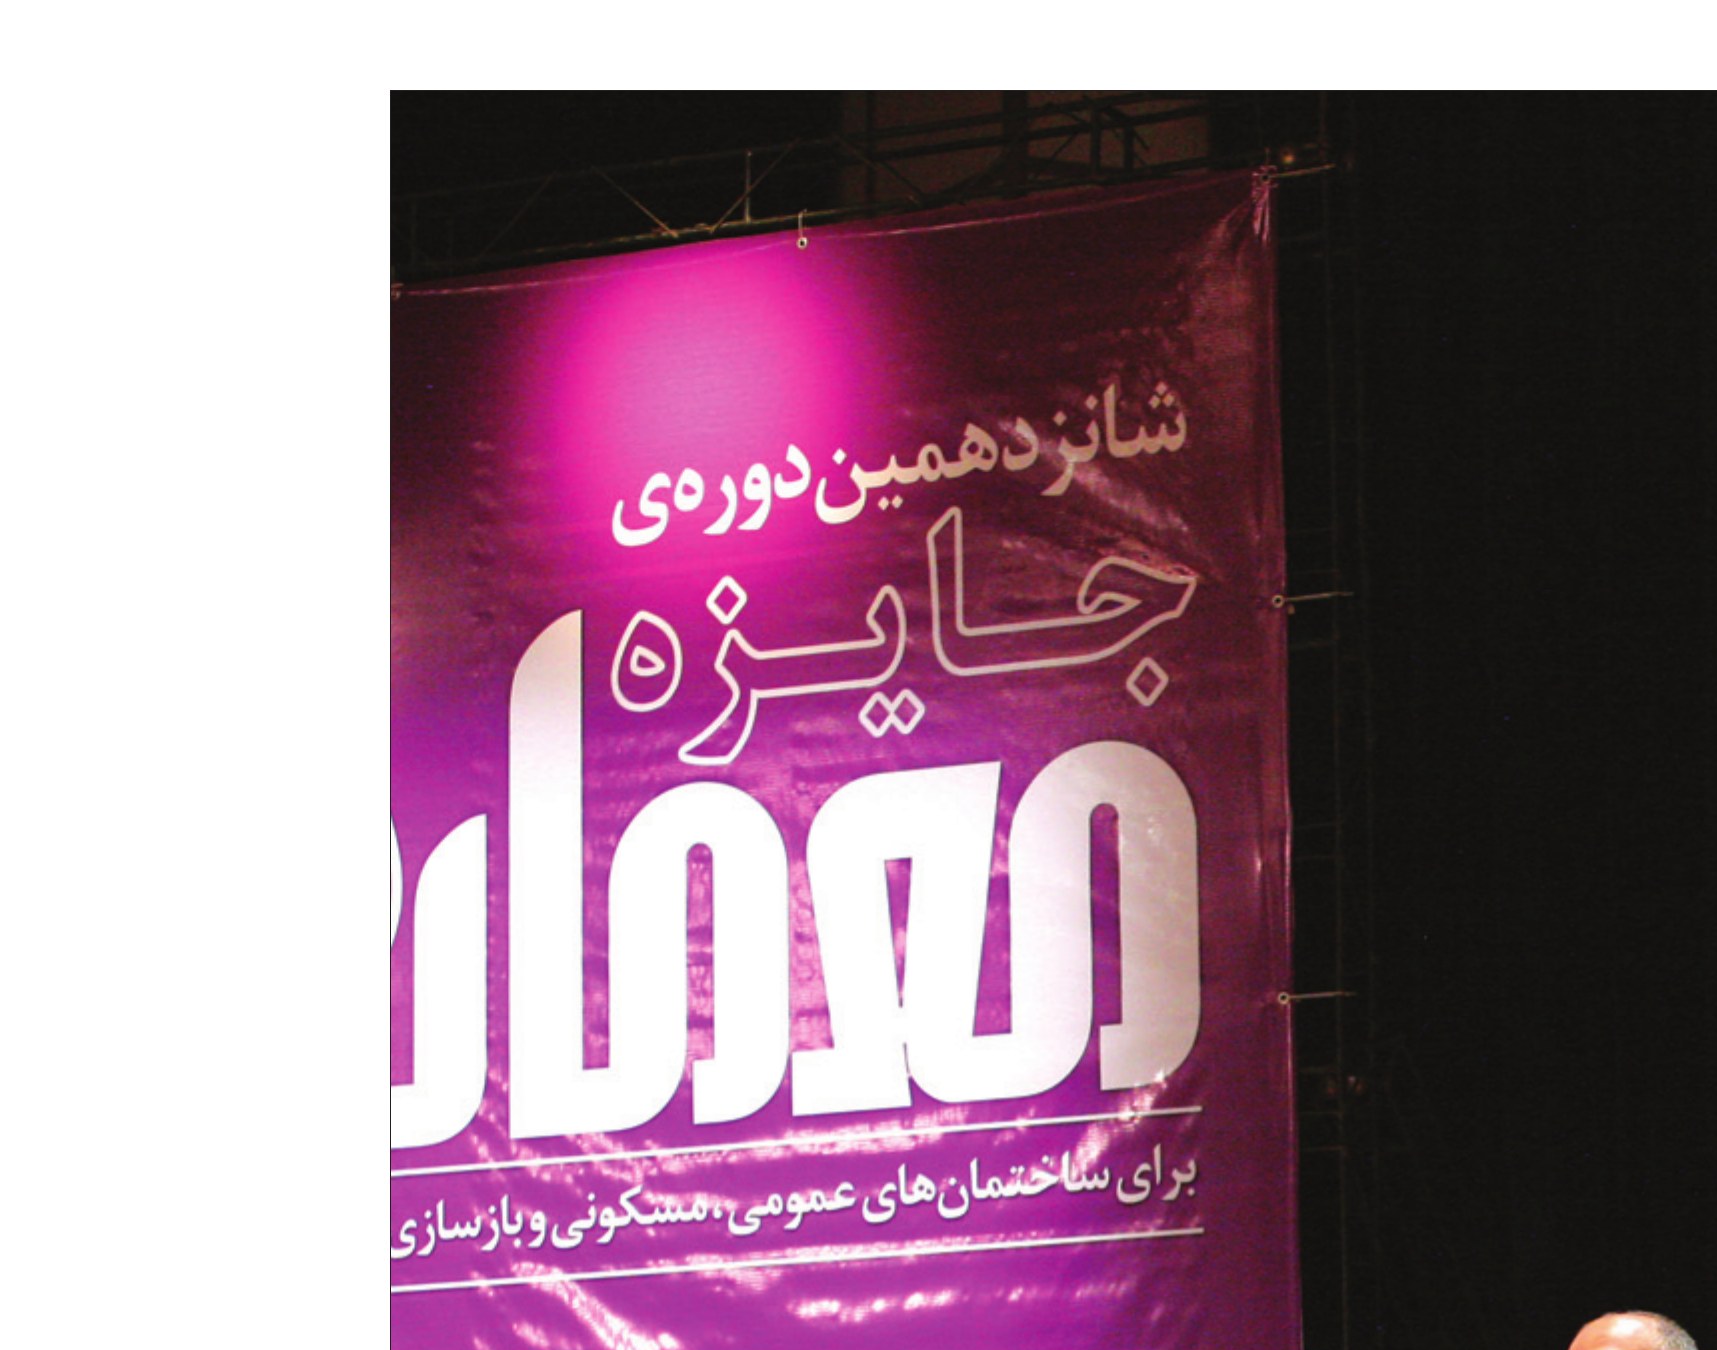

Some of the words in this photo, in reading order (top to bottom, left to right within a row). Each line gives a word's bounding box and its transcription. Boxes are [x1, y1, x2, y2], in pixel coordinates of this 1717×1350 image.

[815, 380, 1188, 525] شانزدهمین
[610, 505, 1198, 767] جایزه
[391, 608, 1200, 1149] معمار
[528, 1217, 548, 1247] و
[1116, 1143, 1198, 1203] برای
